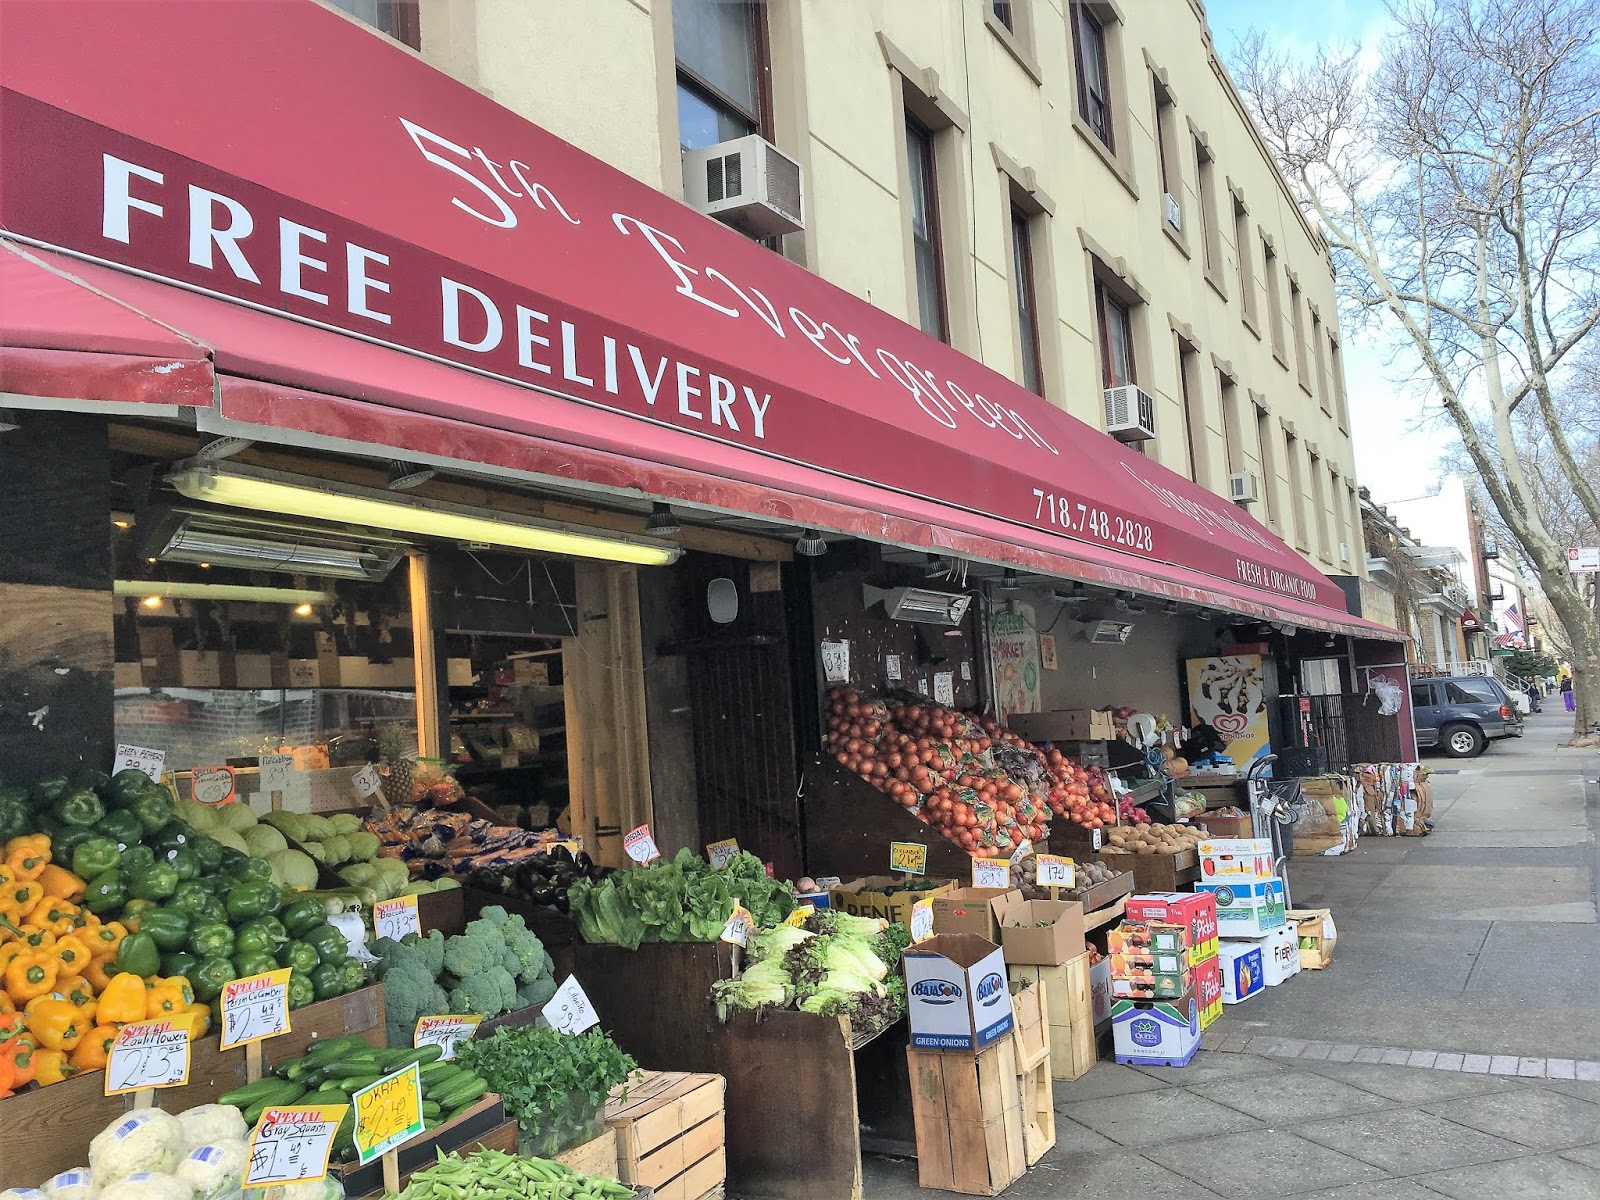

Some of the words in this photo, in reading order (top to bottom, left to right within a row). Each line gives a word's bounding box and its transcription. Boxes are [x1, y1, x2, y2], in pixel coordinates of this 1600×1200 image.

[102, 153, 393, 325] FREE
[441, 276, 772, 439] DELIVERY
[398, 116, 581, 229] 5th
[612, 213, 1060, 456] Evergreen
[1032, 487, 1153, 552] 718.748.2828
[1236, 558, 1262, 585] FRESH
[1263, 568, 1270, 587] &
[1270, 569, 1300, 596] ORGANIC
[1300, 580, 1317, 600] FOOD
[225, 977, 271, 1000] SPECIAL
[914, 981, 960, 998] BAJASN
[978, 977, 1004, 1001] BAJASN
[118, 1021, 171, 1043] SPECIAL
[915, 1037, 939, 1046] GREEN
[940, 1038, 970, 1047] ONIONS
[986, 1025, 997, 1040] GREEN
[1134, 1032, 1158, 1040] QUEEN
[118, 1049, 143, 1091] 2
[360, 1077, 400, 1110] OKRA
[260, 1110, 321, 1131] SPECIAL
